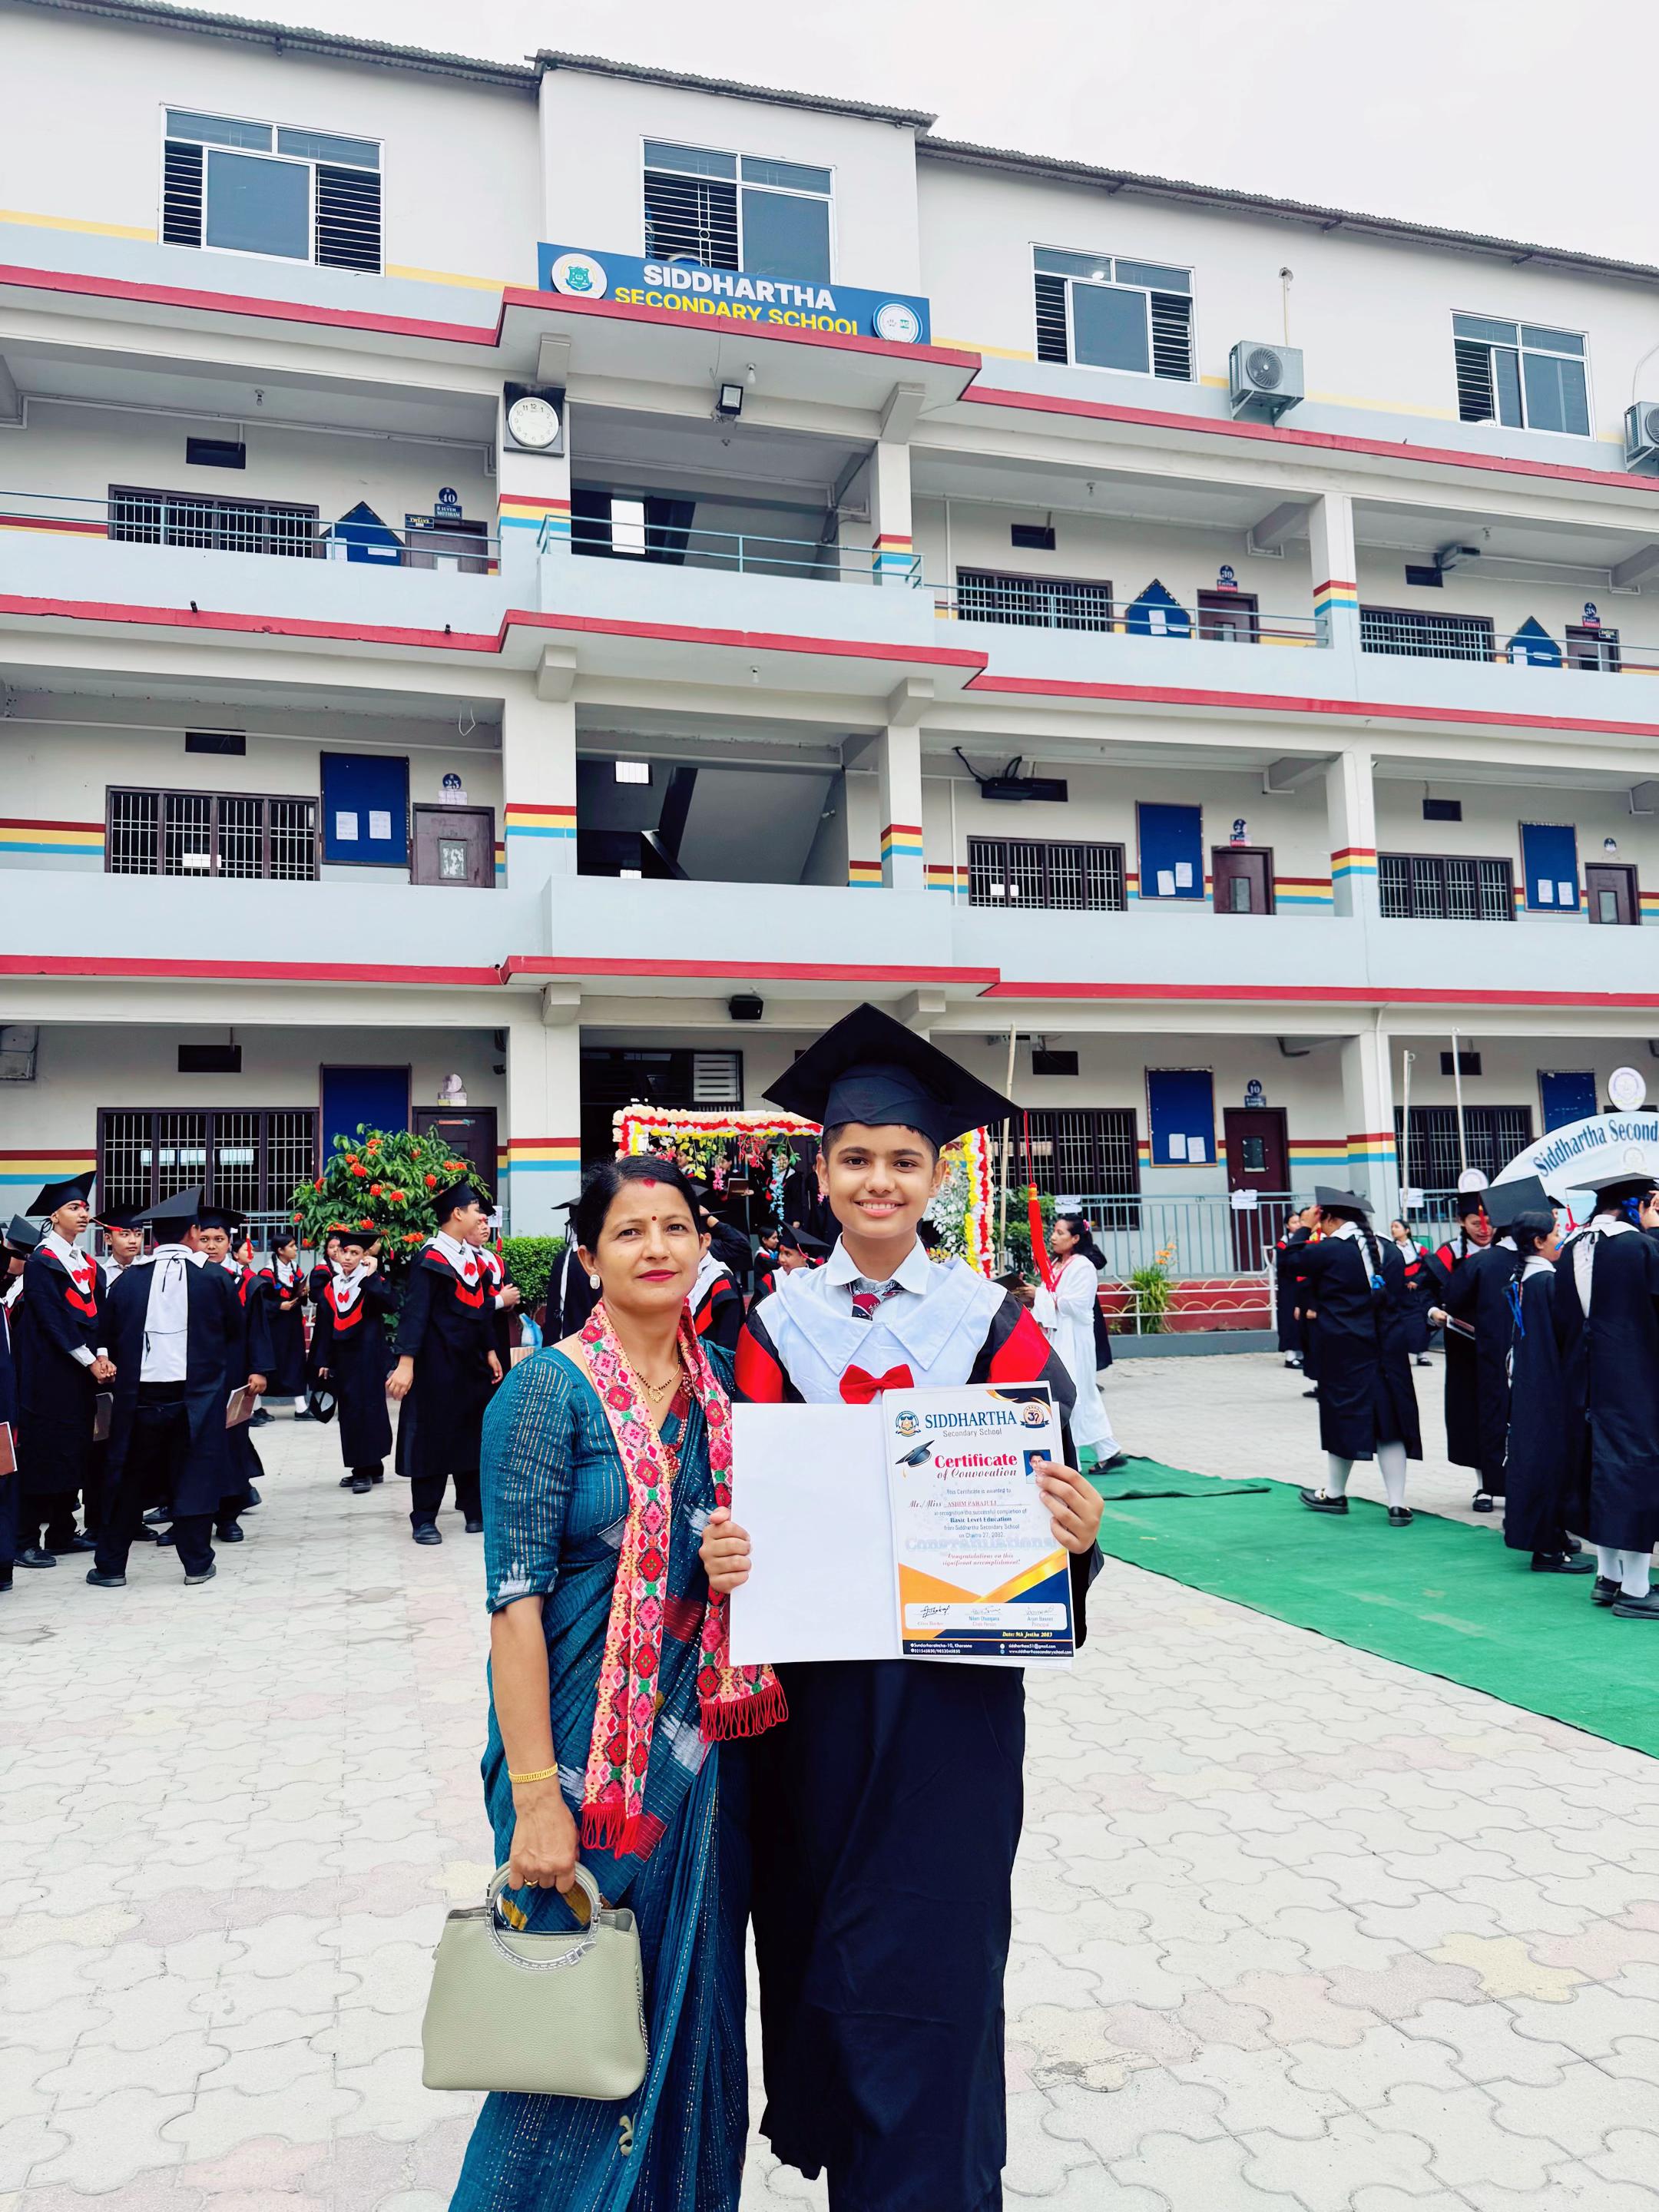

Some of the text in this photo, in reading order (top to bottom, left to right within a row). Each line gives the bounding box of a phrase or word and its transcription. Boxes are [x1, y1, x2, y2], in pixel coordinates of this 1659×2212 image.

[644, 264, 836, 312] SIDDHARTHA
[614, 287, 858, 336] SECONDARY SCHOOL
[1533, 1119, 1659, 1177] Siddhartha Second
[925, 1410, 1017, 1429] SIDDHARTHA
[943, 1428, 1002, 1438] Secondary School
[935, 1453, 1018, 1469] Certificate
[937, 1467, 1017, 1481] of Convocation
